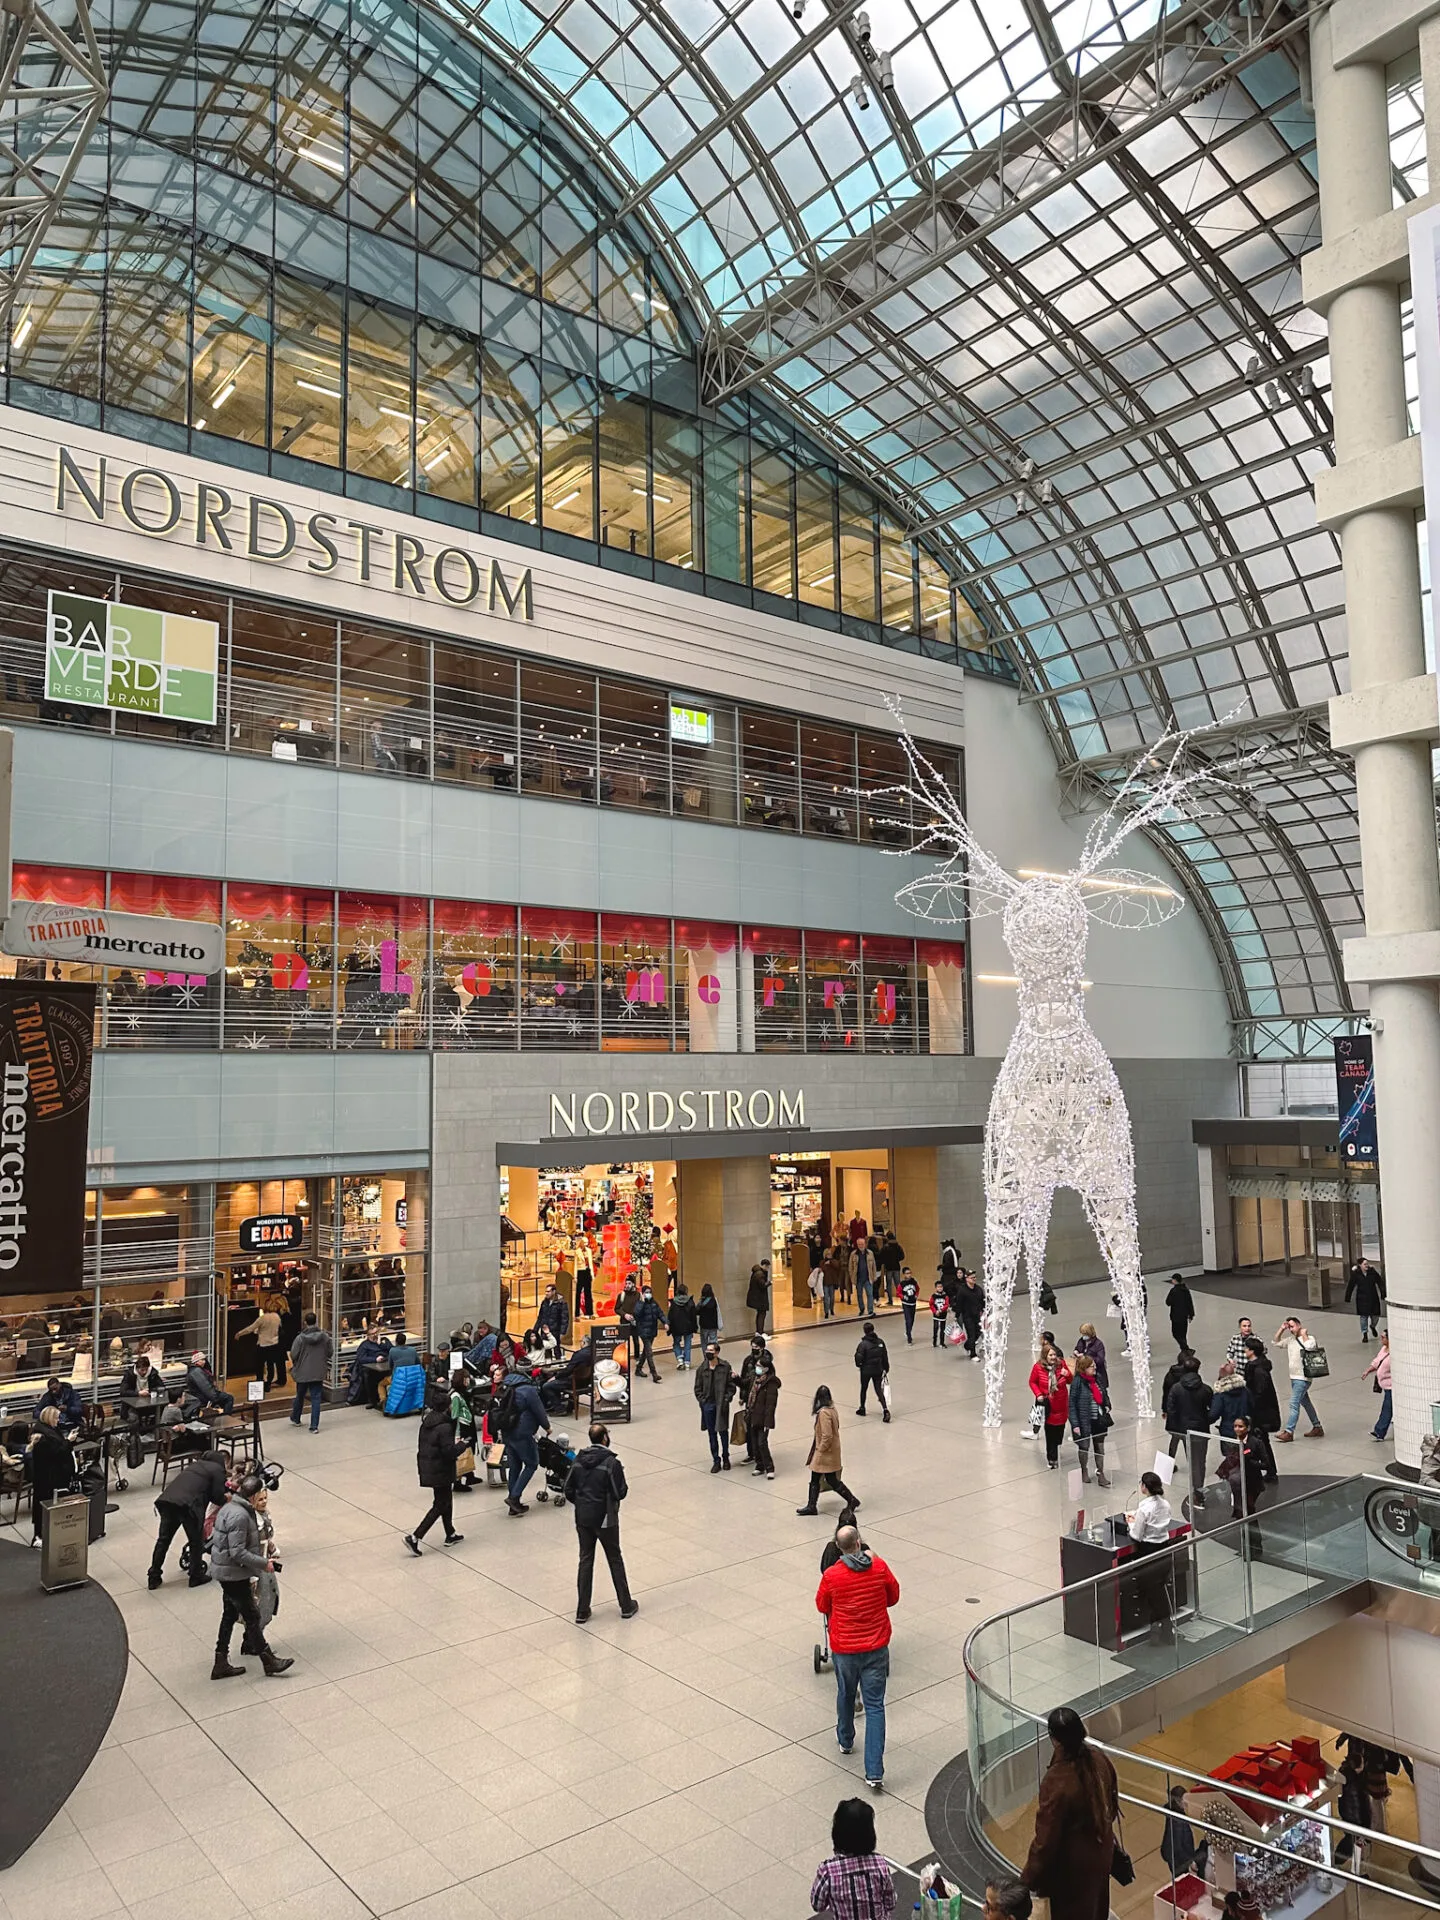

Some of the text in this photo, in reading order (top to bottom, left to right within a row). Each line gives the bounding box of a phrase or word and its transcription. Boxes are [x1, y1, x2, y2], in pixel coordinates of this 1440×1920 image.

[55, 445, 535, 621] NORDSTROM
[50, 613, 132, 659] BAR
[50, 646, 184, 698] VERDE
[53, 682, 160, 709] RESTAURANT
[27, 917, 106, 942] TRATTORIA
[83, 934, 206, 960] mercatto
[47, 1005, 81, 1030] CLASSIC
[12, 1001, 64, 1117] TRATTORIA
[59, 1039, 75, 1067] 1997
[550, 1089, 805, 1136] NORDSTROM
[0, 1061, 30, 1270] mercatto
[251, 1224, 293, 1242] EBAR
[1388, 1504, 1411, 1517] Level
[1395, 1515, 1406, 1532] 3
